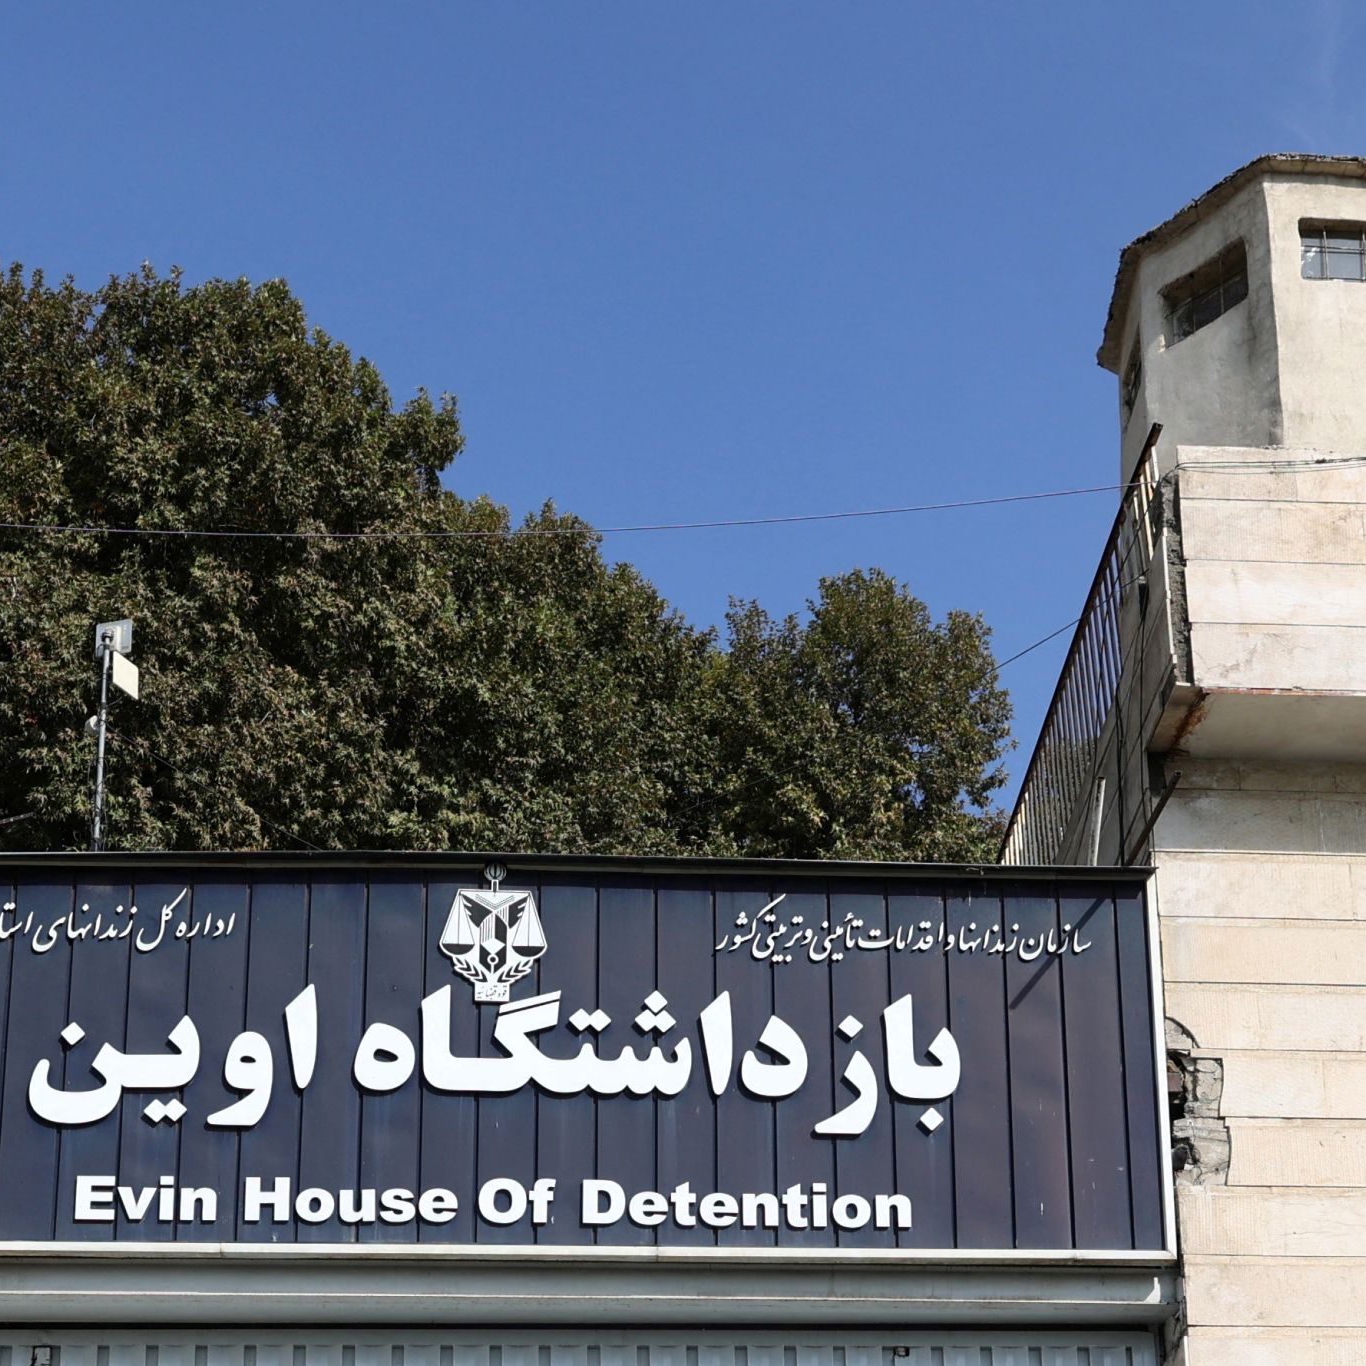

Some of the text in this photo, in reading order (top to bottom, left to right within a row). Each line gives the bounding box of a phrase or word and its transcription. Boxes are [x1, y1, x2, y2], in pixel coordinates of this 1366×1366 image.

[31, 903, 138, 953] زندانهای
[135, 887, 188, 952] کل
[175, 912, 236, 938] اداره
[714, 893, 787, 951] کشور
[856, 920, 945, 950] اقدامات
[958, 922, 1020, 953] زندانها
[1018, 923, 1092, 961] سازمان
[28, 983, 962, 1136] بازداشتگاه اوین
[73, 1175, 913, 1229] Evin House Of Detention
